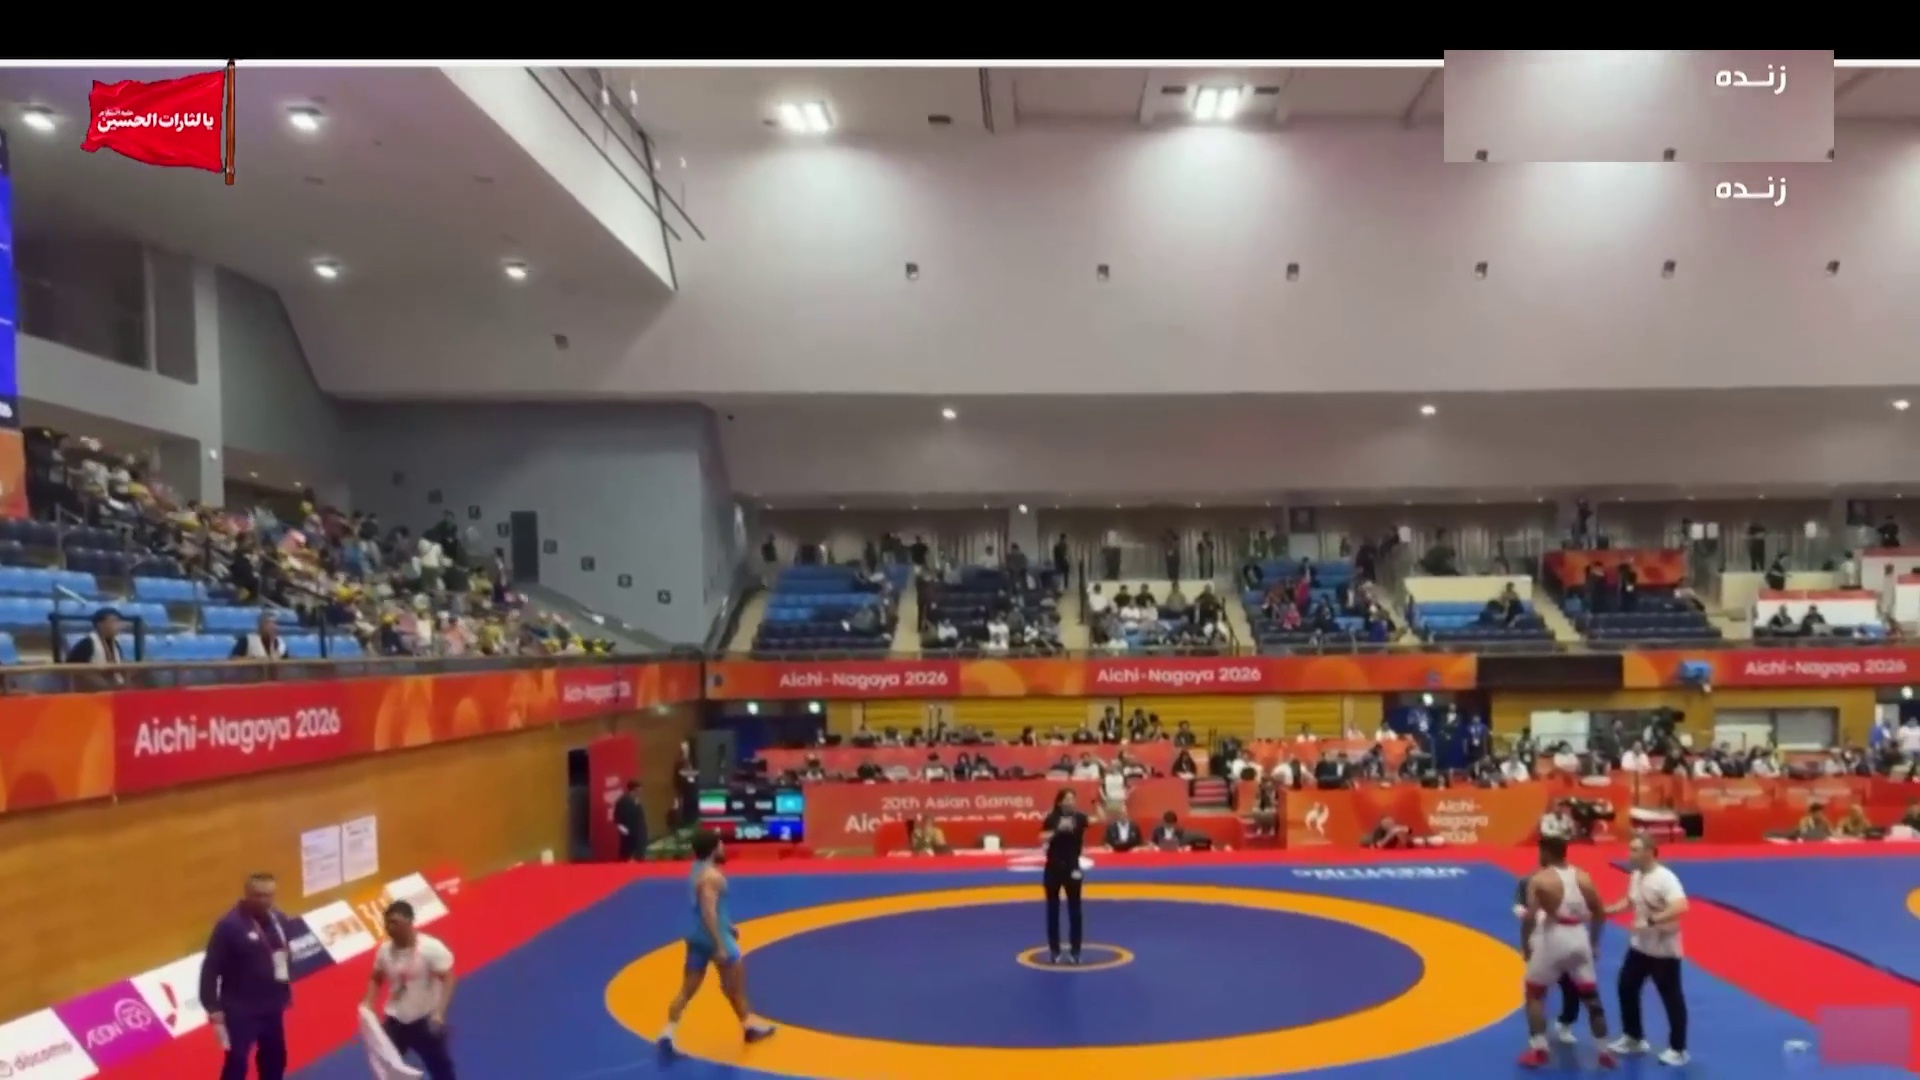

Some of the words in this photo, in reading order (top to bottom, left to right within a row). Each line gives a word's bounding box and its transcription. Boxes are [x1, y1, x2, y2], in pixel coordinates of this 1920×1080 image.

[1097, 666, 1215, 687] Aichi-Nagoya
[1218, 666, 1262, 683] 2026
[1744, 658, 1862, 679] Aichi-Nagoya
[779, 671, 900, 691] Aichi-Nagoya
[904, 671, 949, 687] 2026
[133, 714, 291, 758] Aichi-Nagoya
[294, 706, 341, 740] 2026
[881, 796, 920, 811] 20th
[924, 796, 971, 810] Asian
[974, 794, 1035, 810] Games
